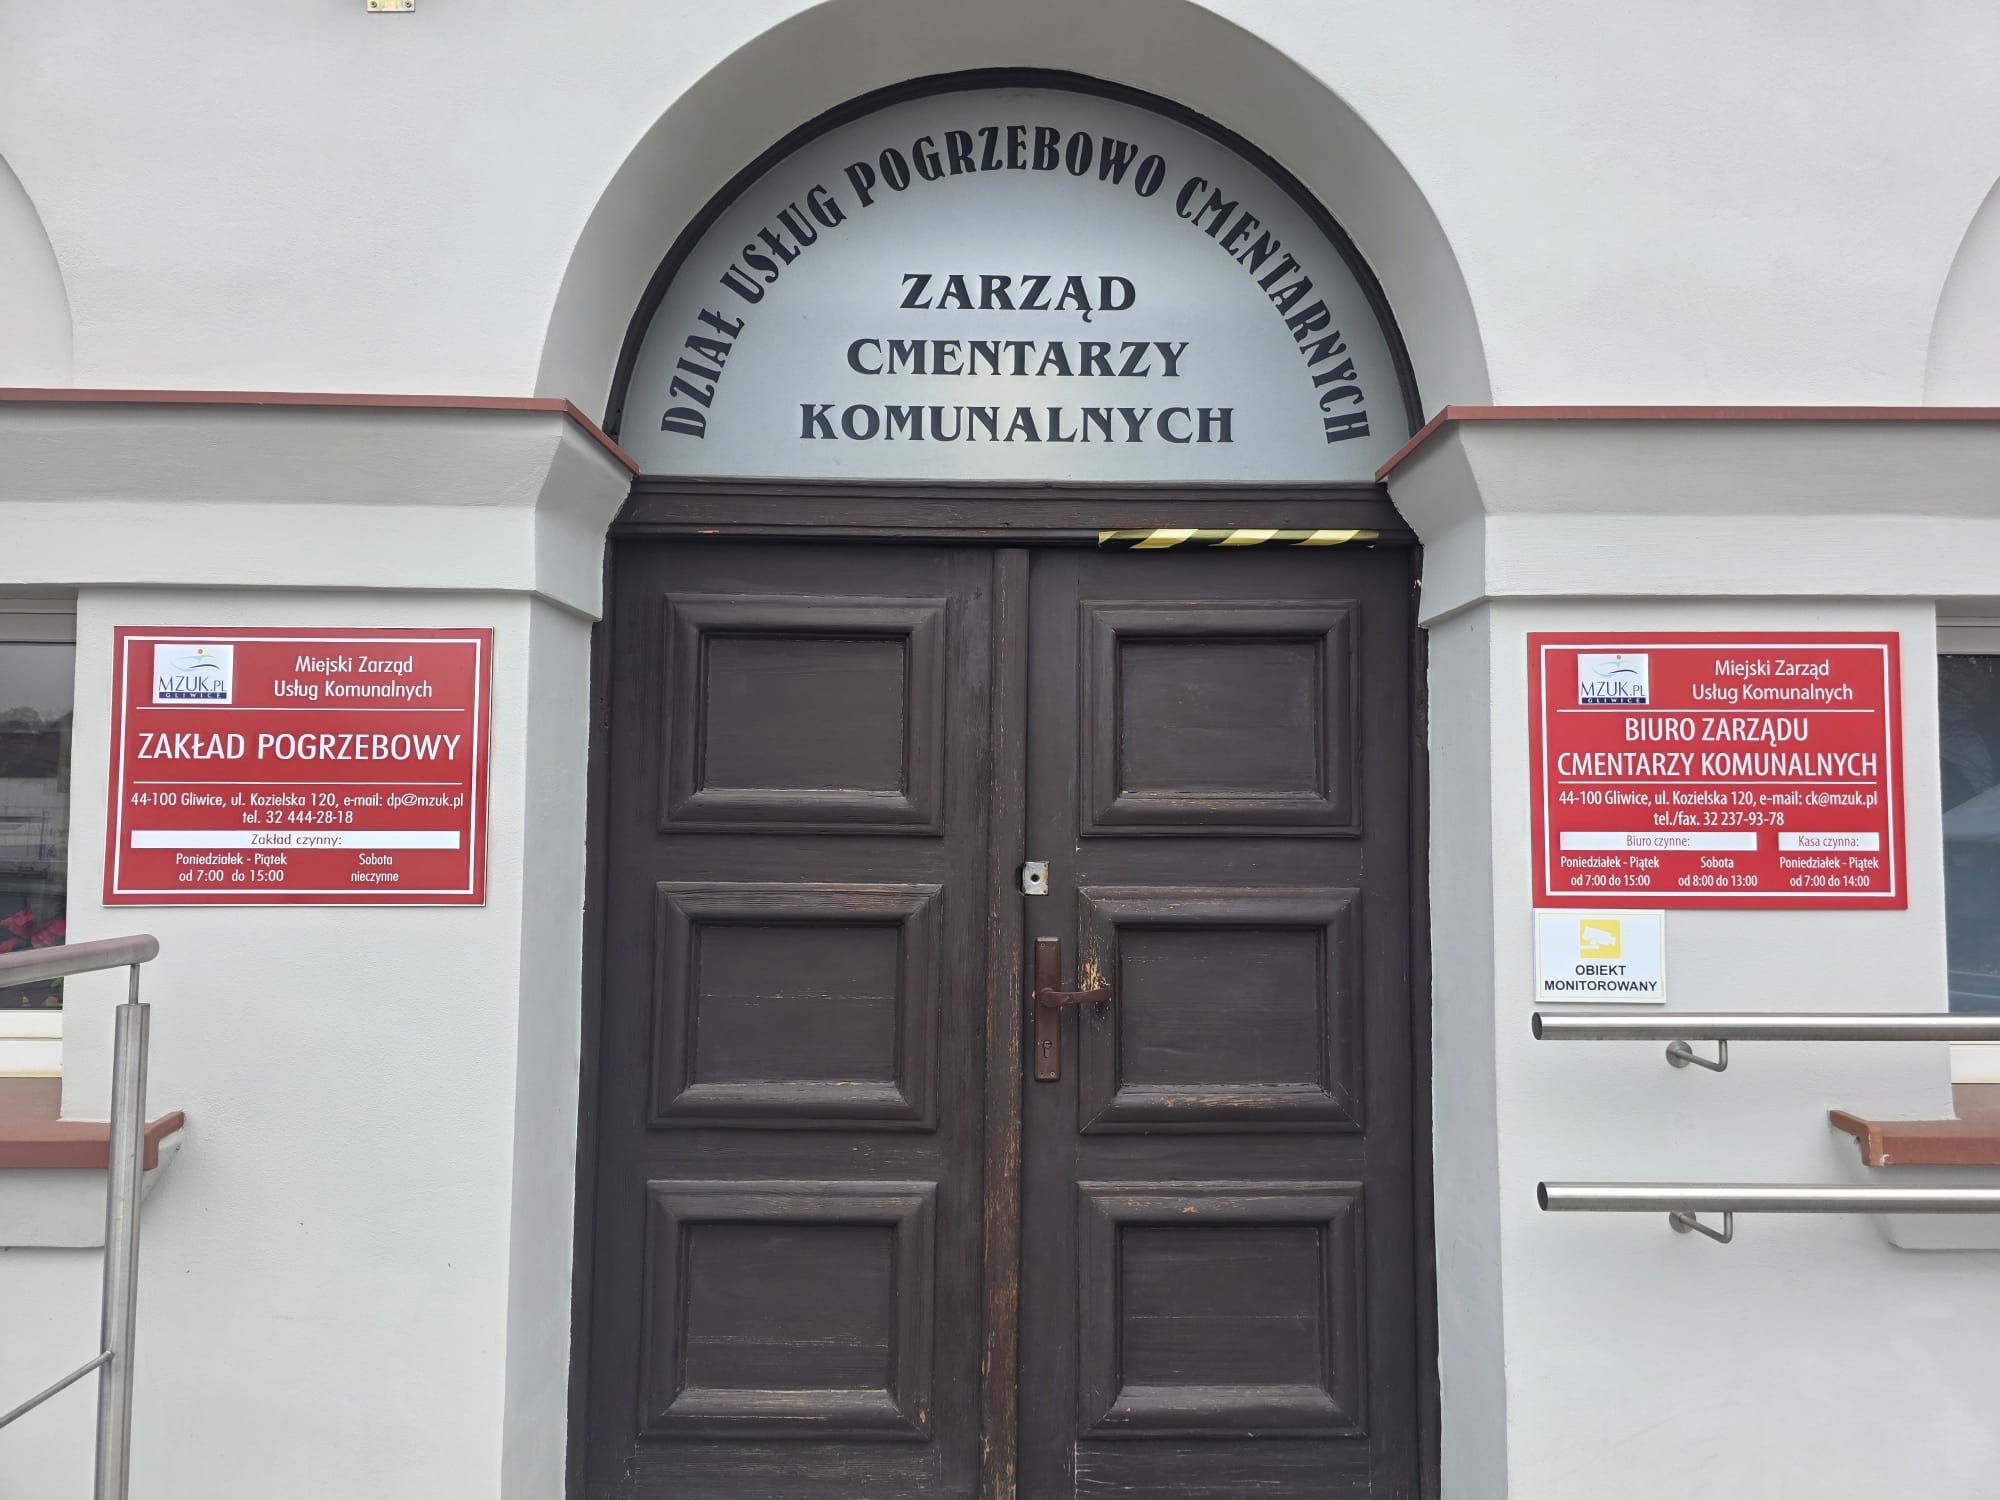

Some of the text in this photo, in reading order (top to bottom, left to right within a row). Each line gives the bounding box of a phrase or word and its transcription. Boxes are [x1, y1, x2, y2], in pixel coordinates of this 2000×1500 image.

[661, 125, 1371, 445] DZIAŁ USŁUG POGRZEBOWO CMENTARNYCH
[900, 273, 1136, 323] ZARZĄD
[847, 338, 1189, 379] CMENTARZY
[800, 403, 1234, 445] KOMUNALNYCH
[295, 656, 413, 676] Miejski Zarząd
[1715, 660, 1829, 680] Miejski Zarząd
[159, 675, 227, 692] MZUK.PL
[274, 680, 433, 701] Usług Komunalnych
[1581, 681, 1646, 697] MZUK.PL
[1692, 685, 1853, 703] Usług Komunalnych
[1625, 718, 1808, 746] BIURO ZARZĄDU
[138, 733, 461, 760] ZAKŁAD POGRZEBOWY
[1558, 752, 1877, 777] CMENTARZY KOMUNALNYCH
[131, 792, 463, 809] 44-100 Gliwice, ul. Kozielska 120, e-mail: dp@mzuk.pl
[1559, 791, 1878, 809] 44-100 Gliwice, ul. Kozielska 120, e-mail: ck@mzuk.pl
[242, 811, 353, 824] tel. 32 444-28-18
[1654, 811, 1784, 826] tel./fax. 32 237-93-78
[251, 834, 342, 847] Zakład czynny:
[1626, 835, 1690, 848] Biuro czynne:
[1798, 835, 1859, 848] Kasa czynna:
[255, 853, 287, 867] Piątek
[359, 853, 392, 865] Sobota
[1560, 856, 1621, 868] Poniedziałek
[1630, 856, 1659, 870] Piątek
[1700, 857, 1734, 868] Sobota
[1779, 856, 1840, 869] Poniedziałek
[1849, 857, 1879, 870] Piątek
[179, 869, 284, 882] od 7:00 do 15:00
[351, 870, 398, 884] nieczynne
[1571, 875, 1650, 886] od 7:00 do 15:00
[1678, 875, 1757, 887] od 8:00 do 13:00
[1790, 875, 1869, 887] od 7:00 do 14:00
[1575, 965, 1626, 976] OBIEKT
[1544, 979, 1657, 992] MONITOROWANY
